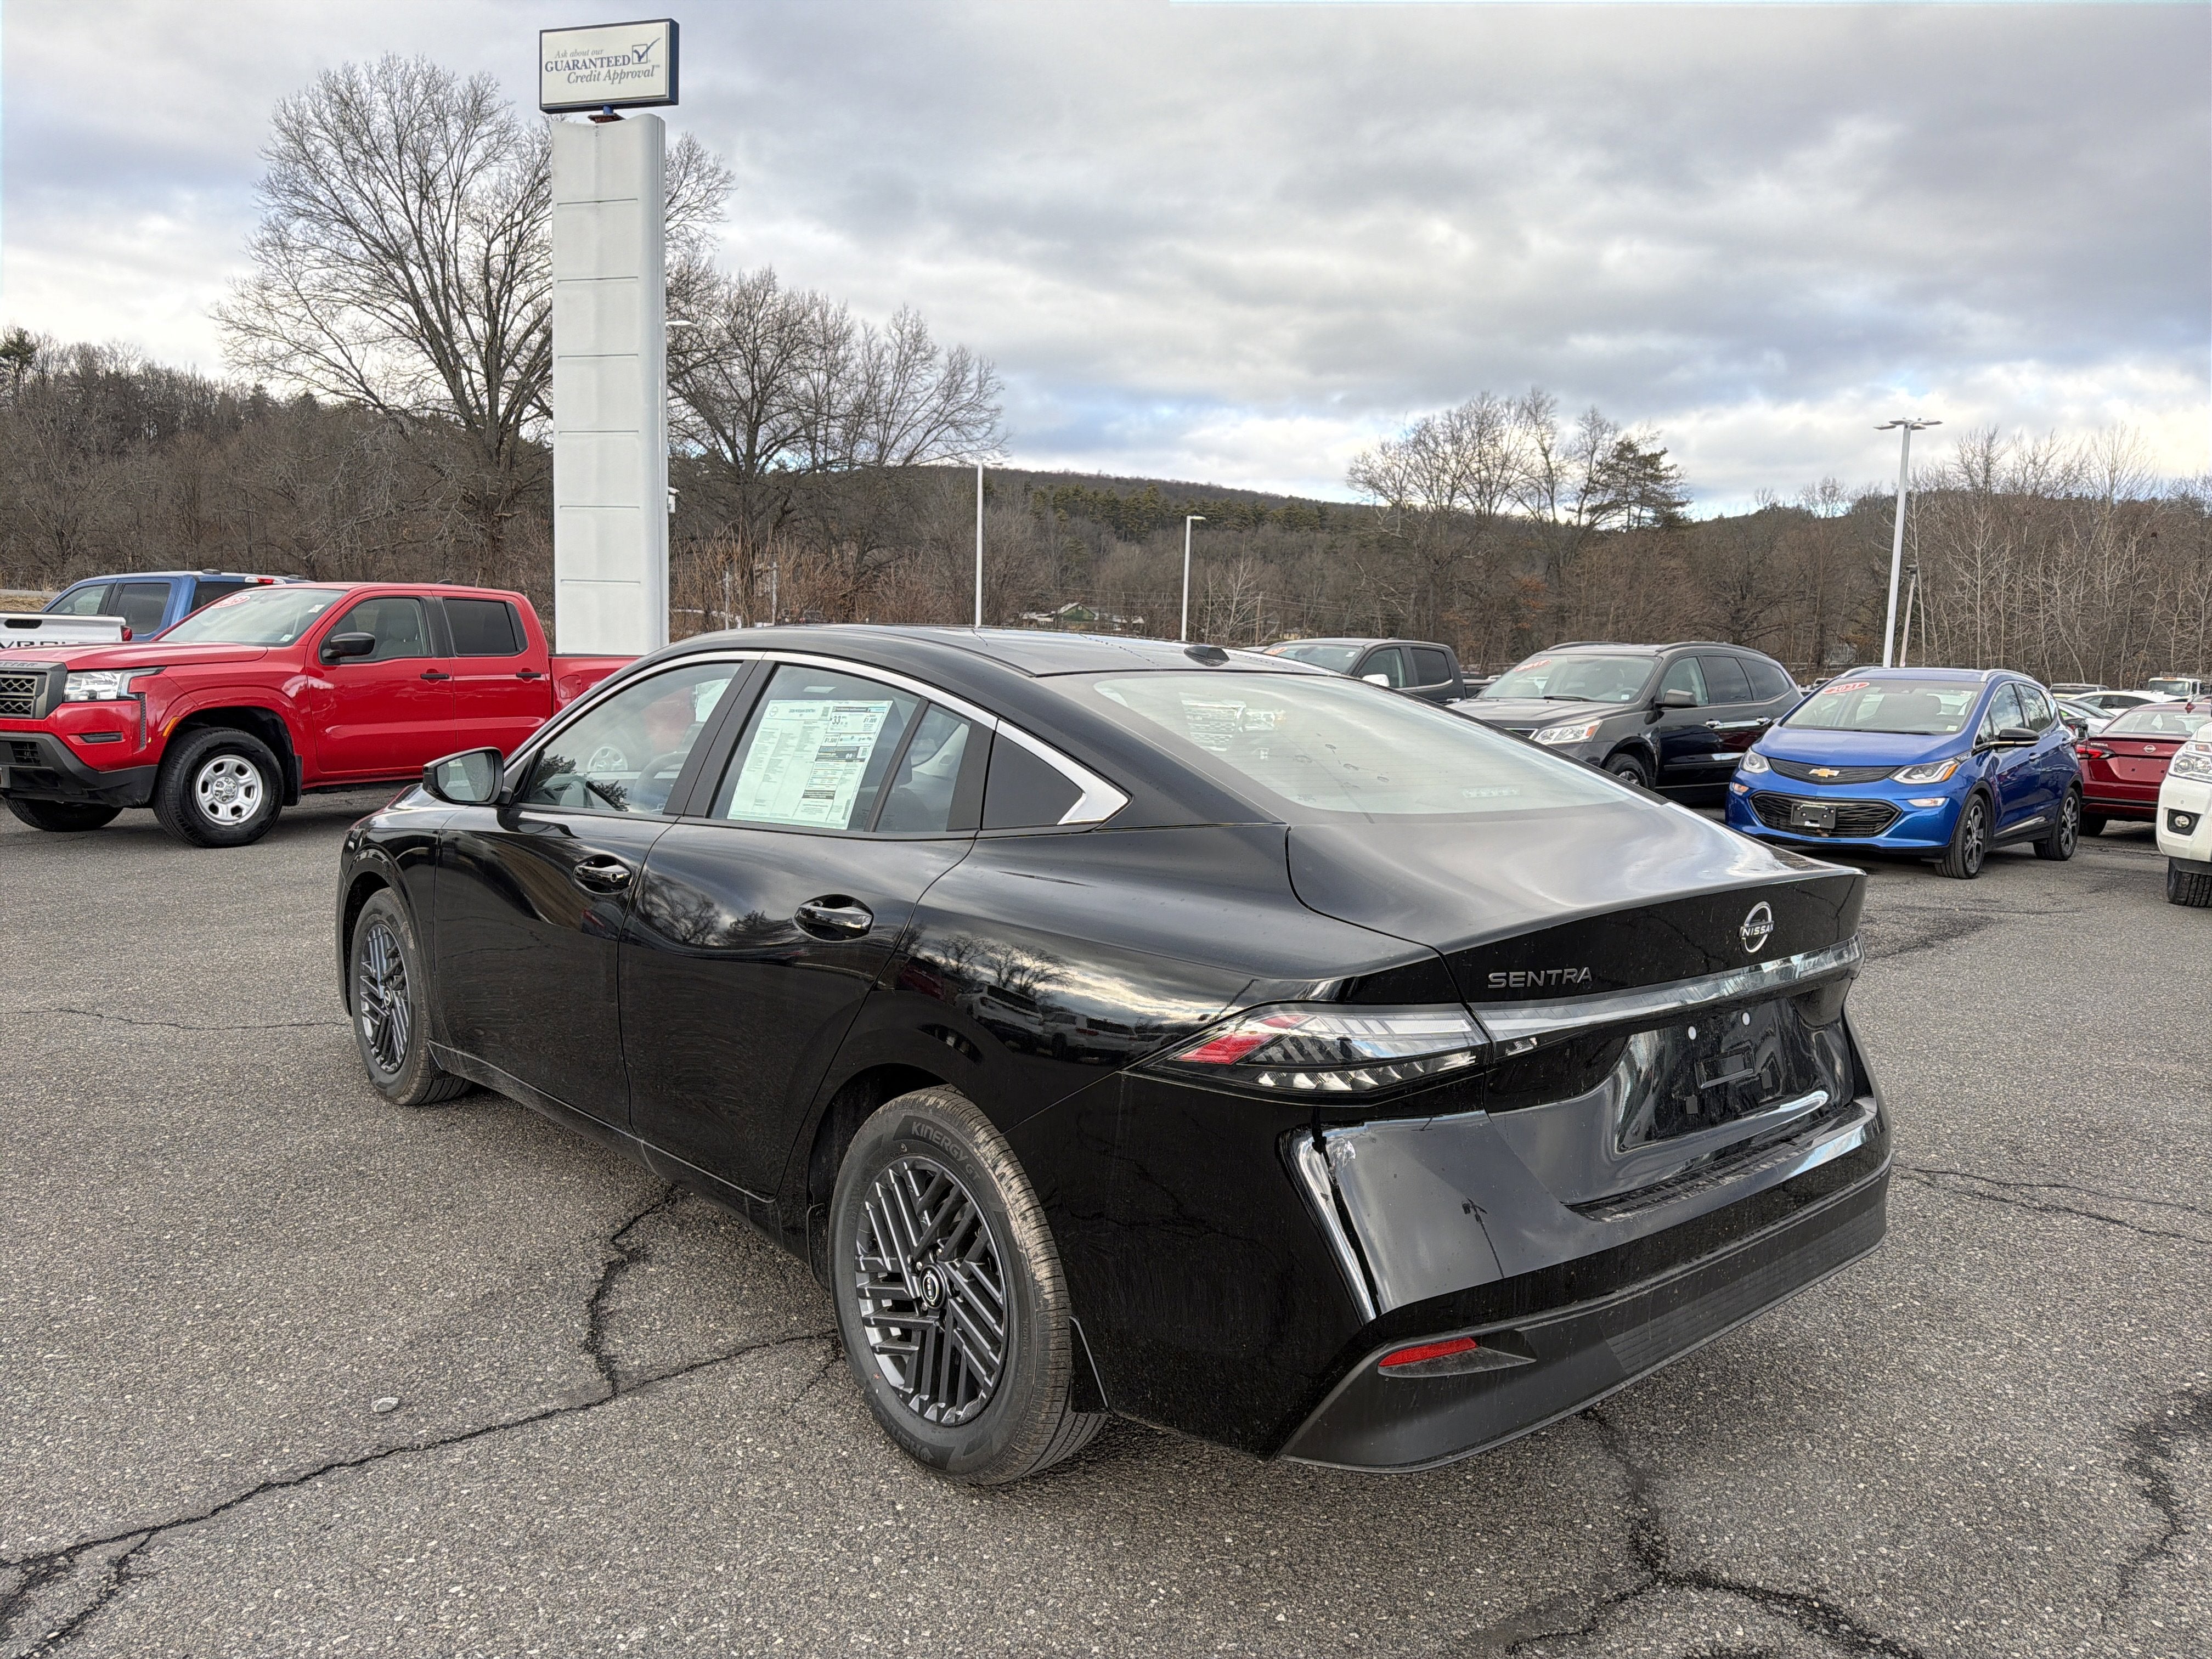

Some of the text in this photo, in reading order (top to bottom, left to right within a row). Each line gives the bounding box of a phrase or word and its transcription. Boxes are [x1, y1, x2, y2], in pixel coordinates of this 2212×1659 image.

[555, 49, 568, 58] Ask
[569, 49, 589, 57] about
[545, 54, 630, 72] GUARANTEED
[567, 70, 601, 84] Credit
[1742, 923, 1773, 936] NISSAN
[1487, 967, 1592, 989] SENTRA
[911, 1121, 981, 1180] KINERGY GT
